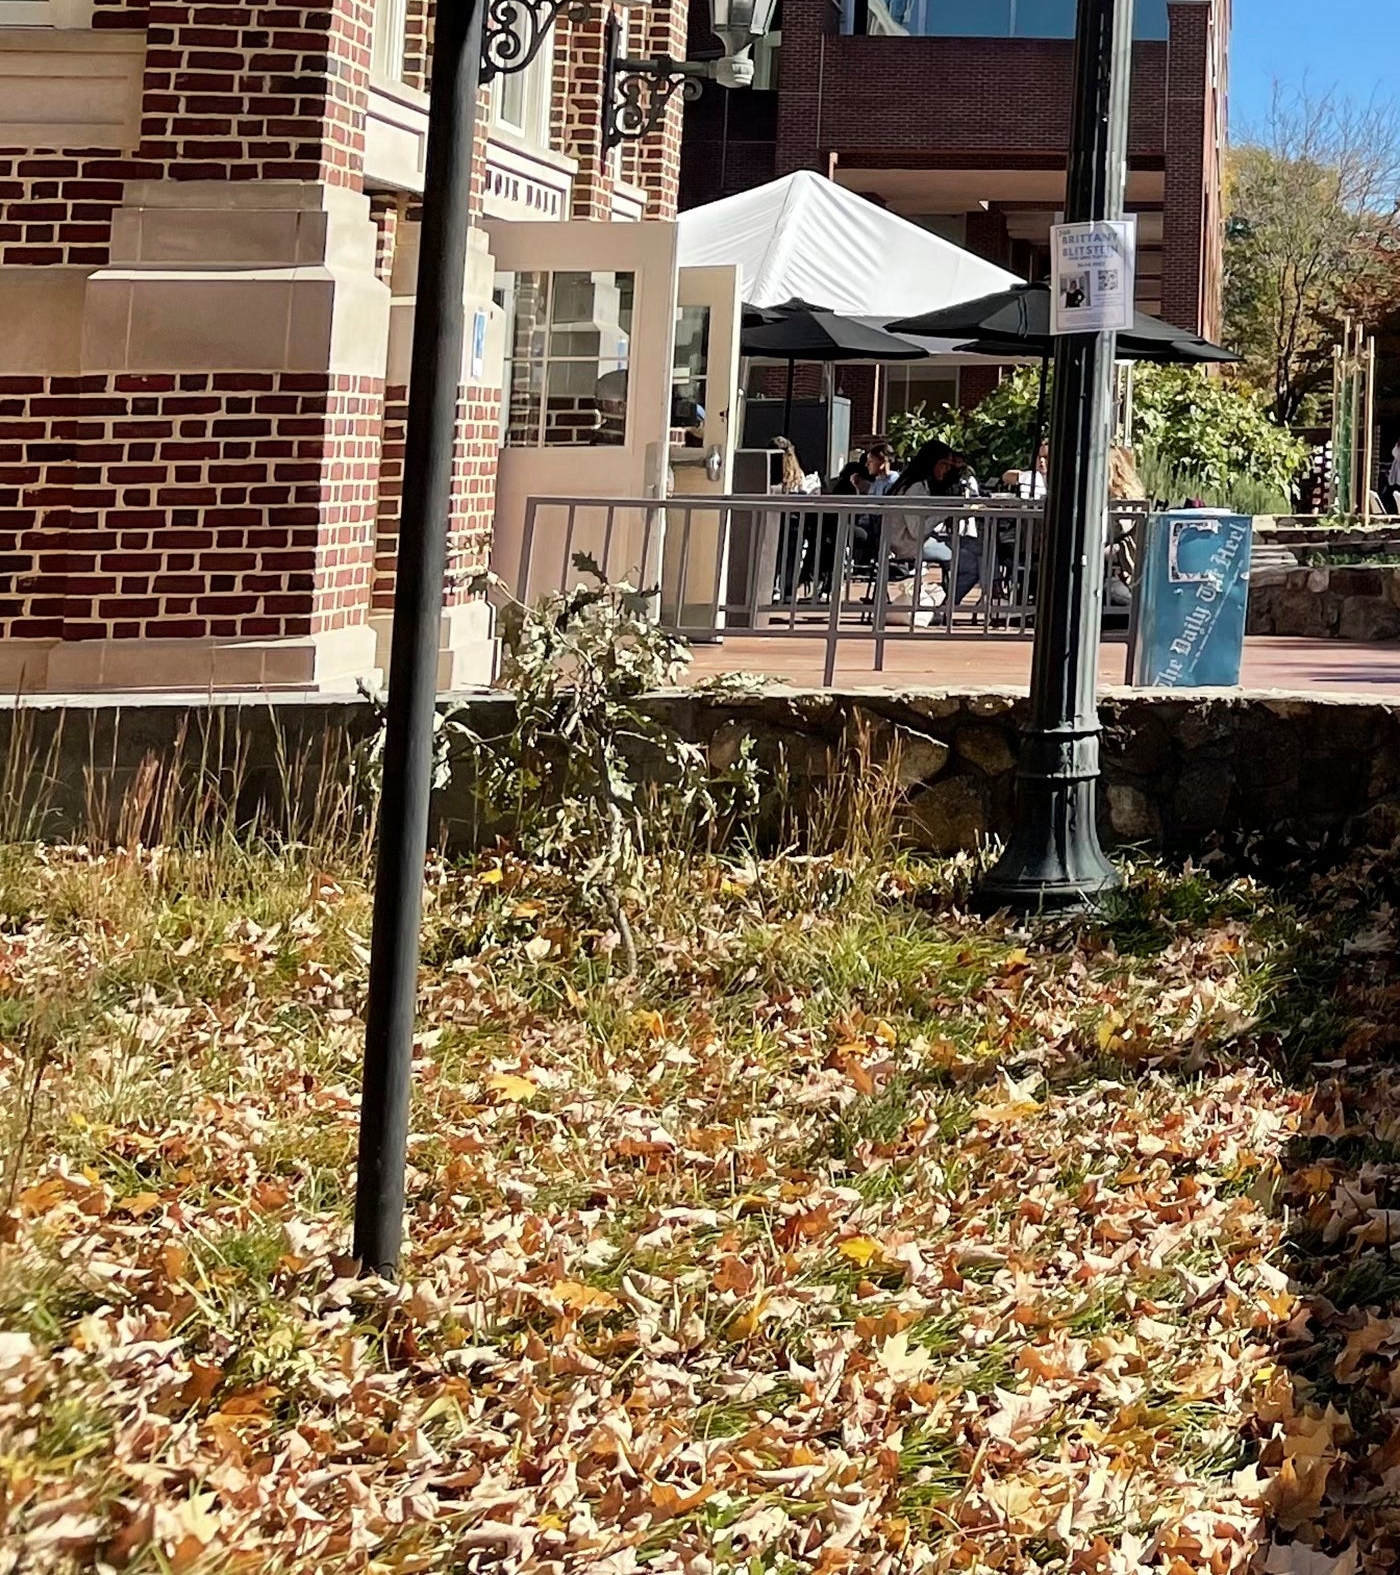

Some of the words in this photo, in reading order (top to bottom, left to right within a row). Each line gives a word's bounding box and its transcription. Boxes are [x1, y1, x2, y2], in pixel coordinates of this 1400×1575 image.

[1062, 233, 1118, 245] BRITTANY
[1170, 606, 1212, 656] Daily
[1210, 523, 1247, 572] Heel
